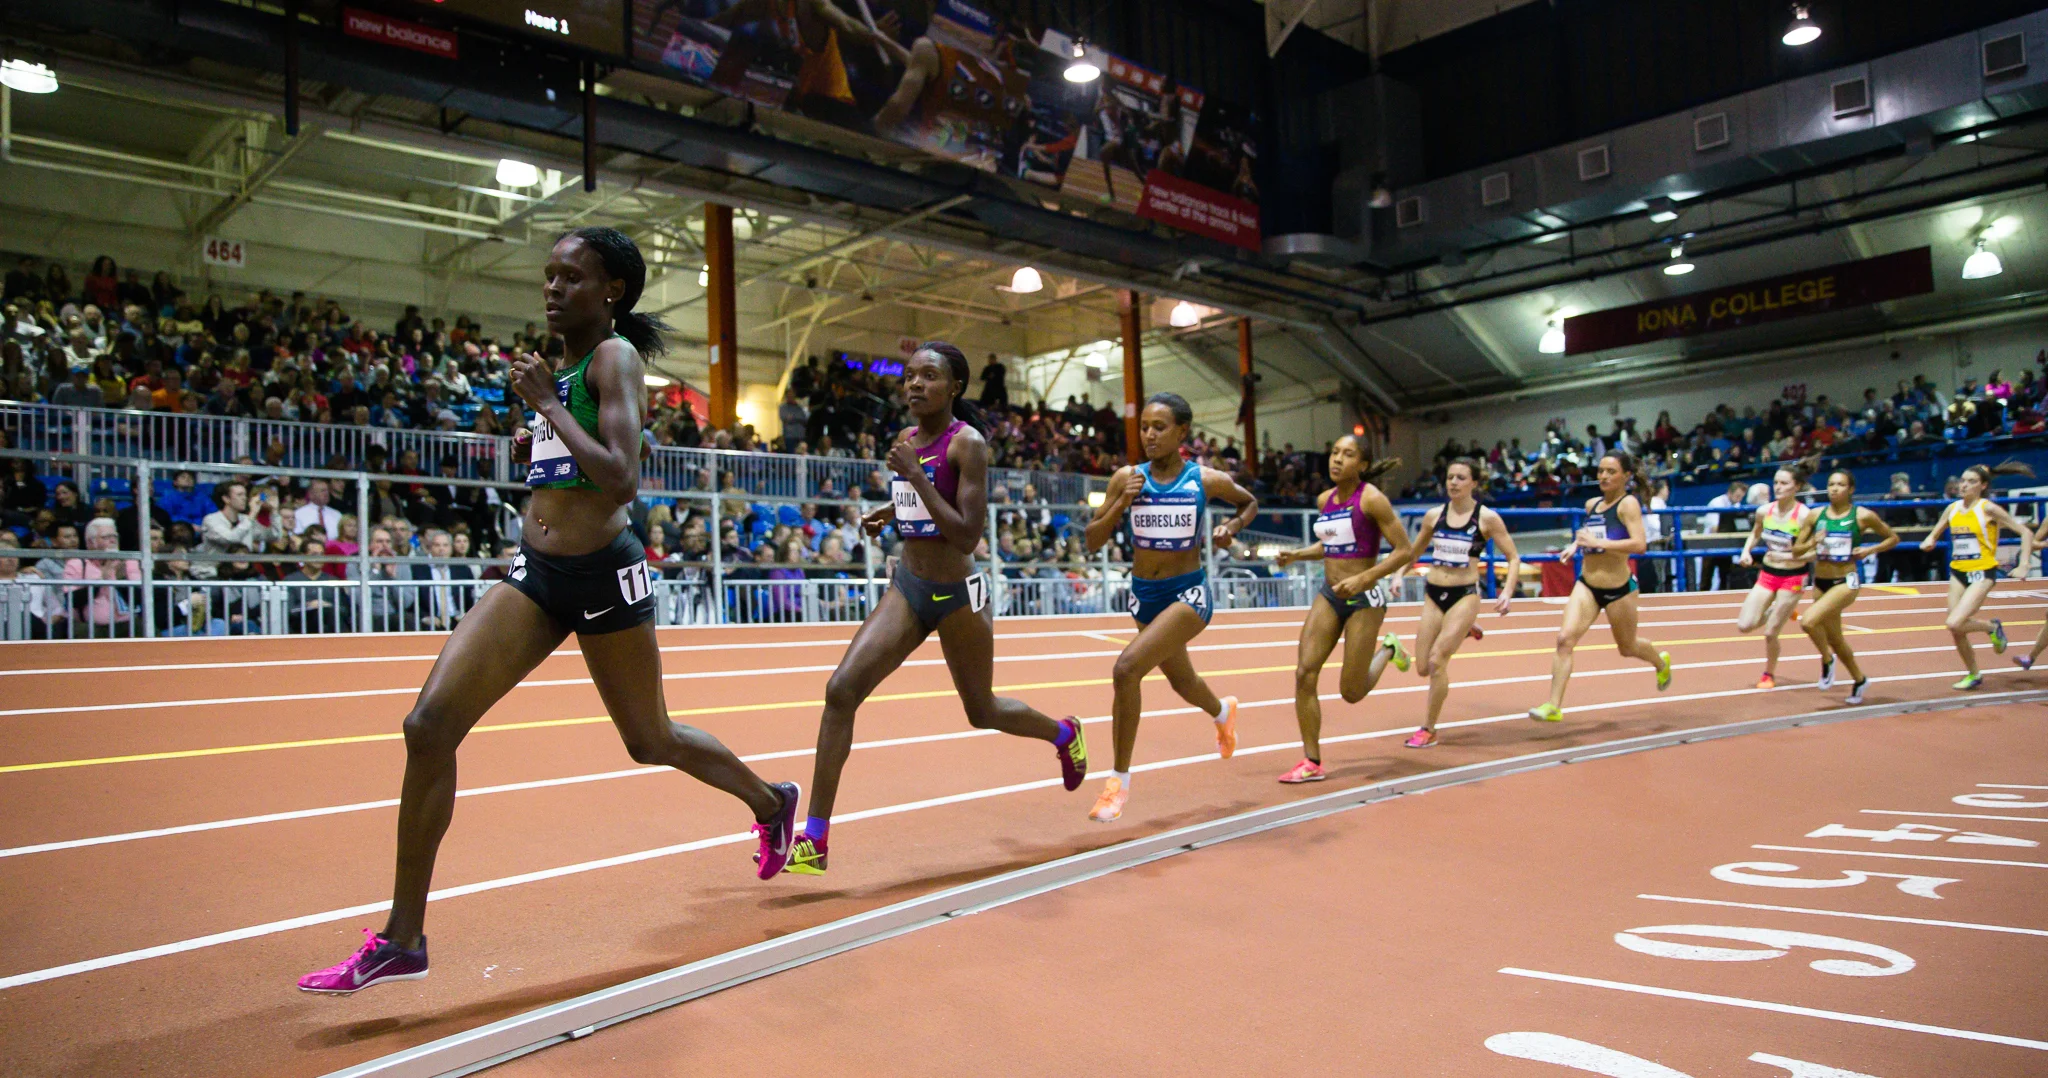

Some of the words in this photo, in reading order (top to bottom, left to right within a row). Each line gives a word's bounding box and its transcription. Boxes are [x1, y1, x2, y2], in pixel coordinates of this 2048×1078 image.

[350, 16, 383, 34] new
[386, 23, 452, 50] balance
[560, 18, 570, 35] 1
[207, 240, 242, 263] 464
[1637, 303, 1697, 333] IONA
[1710, 276, 1837, 319] COLLEGE
[896, 491, 918, 508] SAINA
[1134, 513, 1192, 528] GEBRESLASE
[621, 563, 649, 602] 11
[969, 577, 982, 608] 7
[1709, 860, 1963, 899] 5
